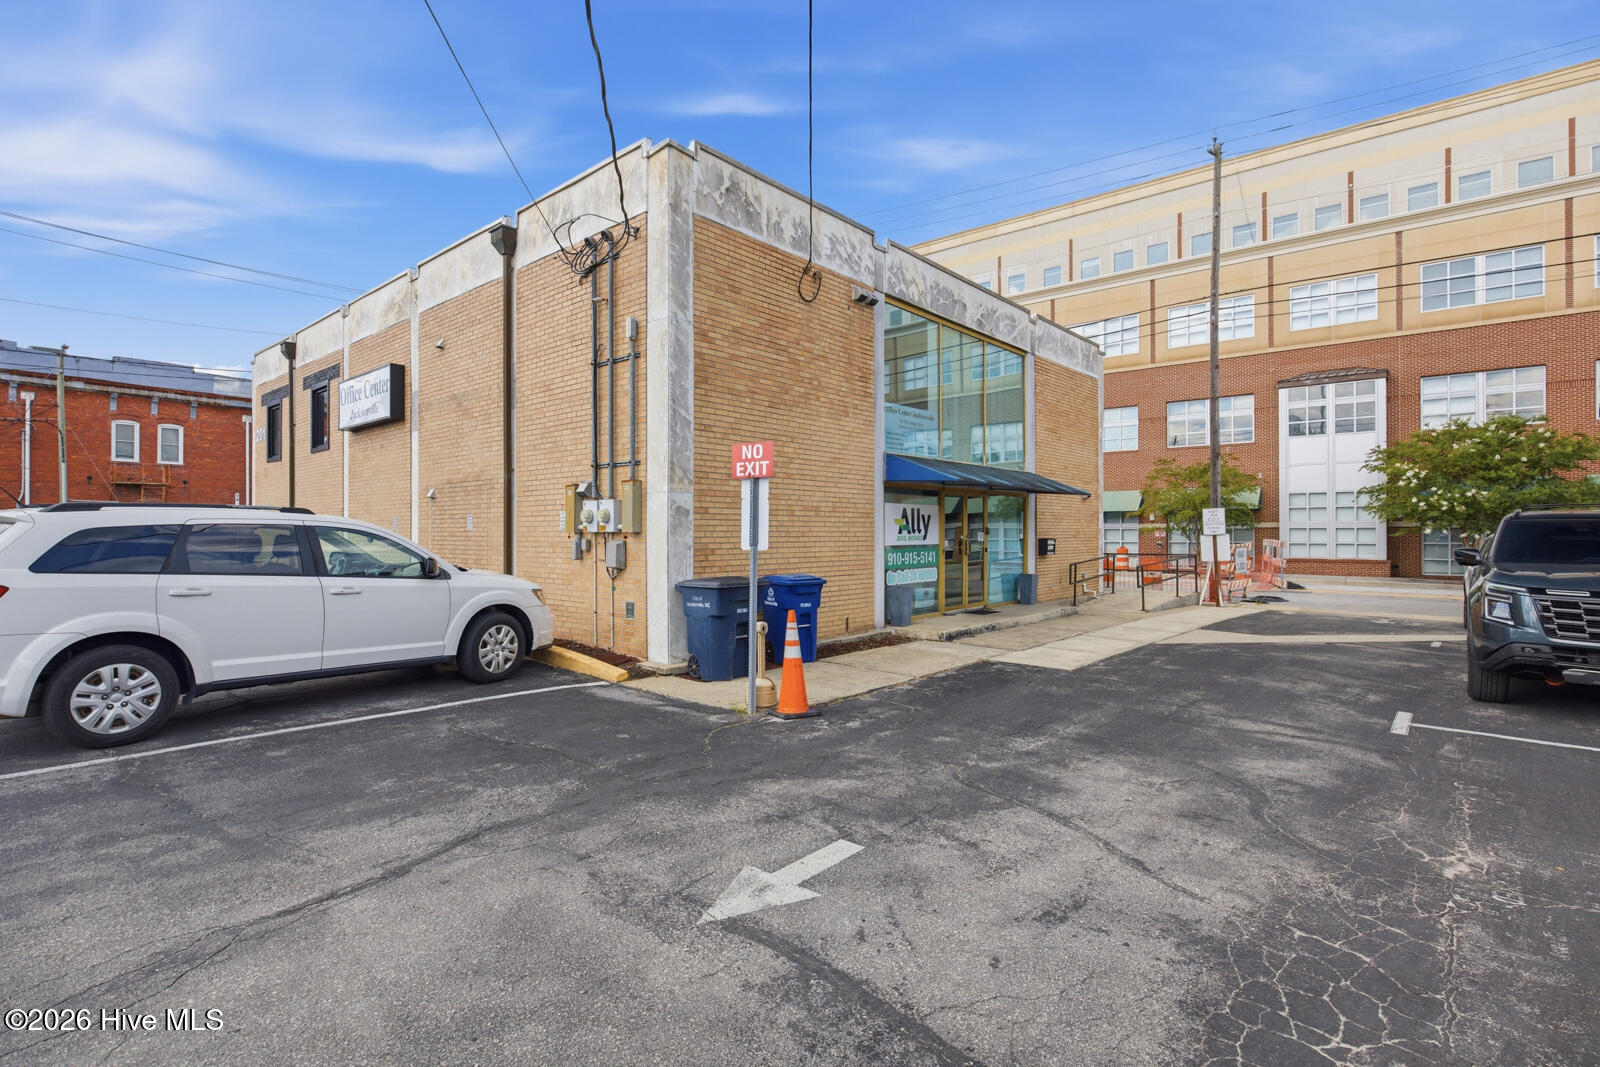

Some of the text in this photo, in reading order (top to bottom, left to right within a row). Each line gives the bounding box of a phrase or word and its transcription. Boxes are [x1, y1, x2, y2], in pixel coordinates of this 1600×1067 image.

[340, 379, 390, 406] Office Center
[741, 443, 764, 460] NO
[735, 460, 770, 477] EXIT
[897, 507, 932, 541] Ally
[887, 550, 936, 566] 910-915-5141
